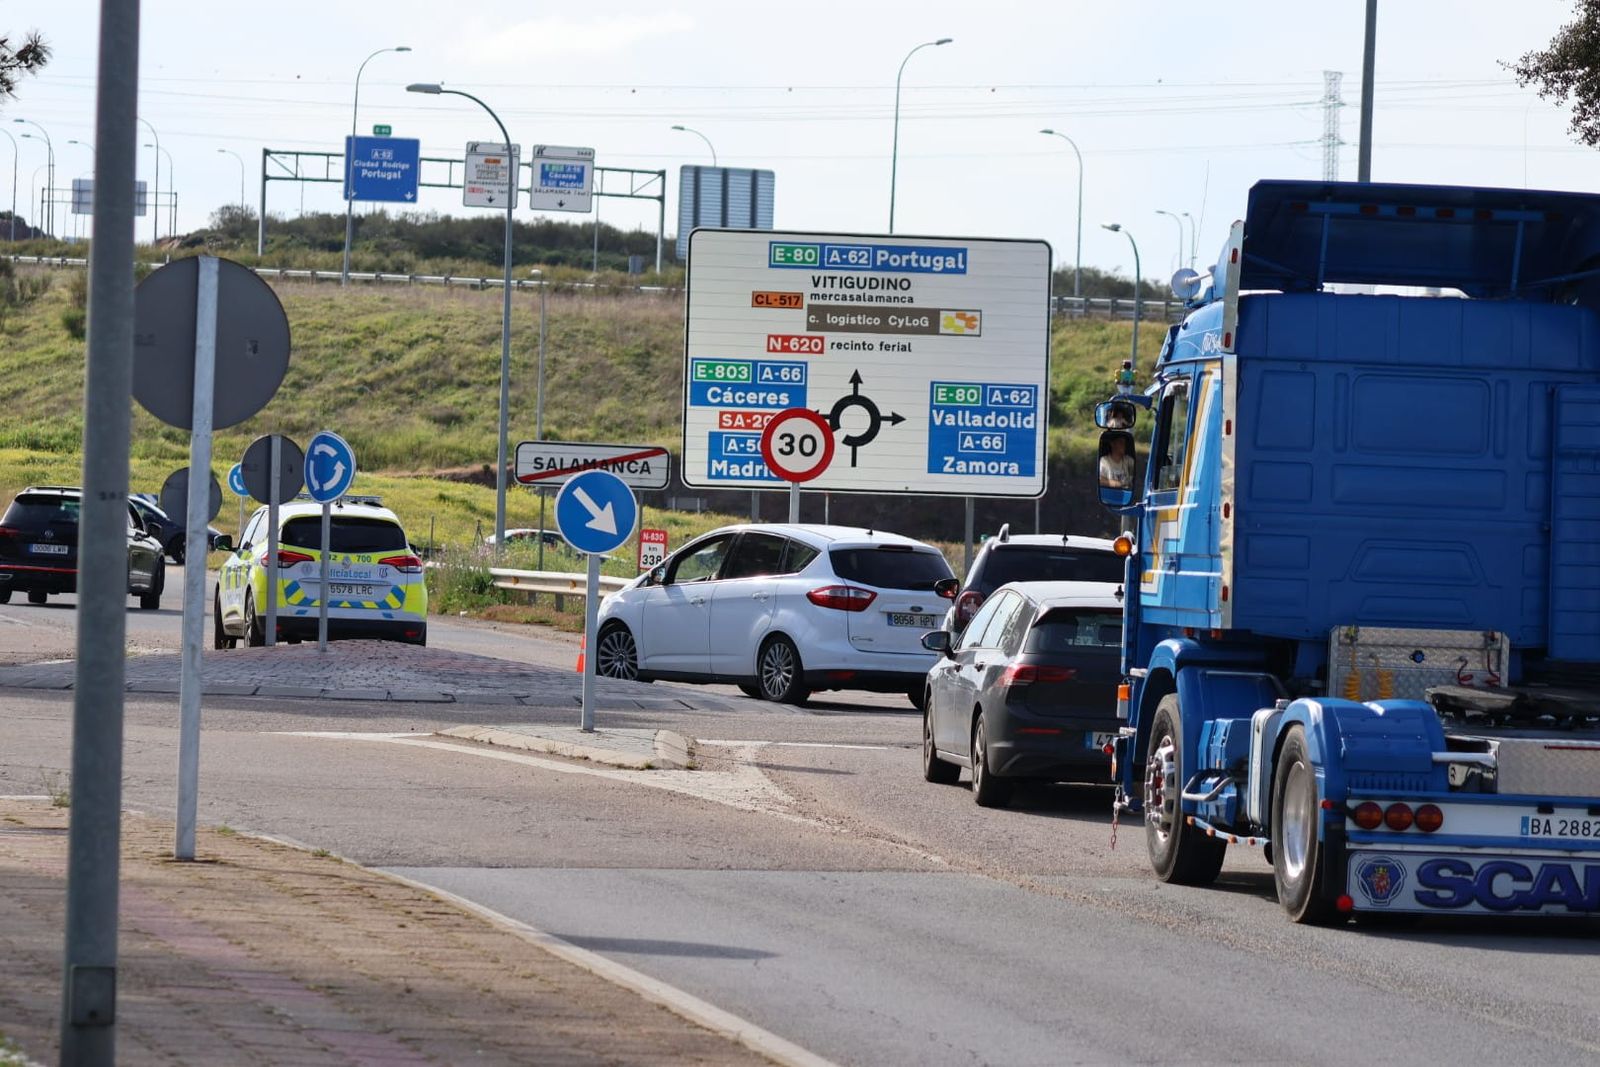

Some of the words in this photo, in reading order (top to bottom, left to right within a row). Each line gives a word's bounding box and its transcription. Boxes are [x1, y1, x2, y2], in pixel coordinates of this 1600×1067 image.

[354, 160, 379, 168] Ciudad
[382, 161, 410, 169] Rodrigo
[361, 168, 401, 180] Portugal
[775, 247, 816, 262] E-80
[829, 250, 869, 264] A-62
[876, 249, 965, 272] Portugal
[811, 275, 911, 291] VITIGUDINO
[754, 294, 800, 306] CL-517
[810, 292, 914, 304] mercasalamanca
[808, 314, 819, 324] c.
[888, 315, 929, 328] CyLoG
[769, 337, 822, 352] N-620
[830, 340, 874, 352] recinto
[879, 340, 912, 352] ferial
[696, 364, 748, 379] E-803
[761, 367, 801, 381] A-66
[706, 386, 790, 405] Cáceres
[937, 387, 978, 402] E-80
[991, 389, 1031, 404] A-62
[931, 409, 1036, 429] Valladolid
[726, 438, 761, 453] A-5
[778, 433, 817, 457] 30
[962, 435, 1003, 450] A-66
[532, 456, 652, 475] SALAMANCA
[711, 459, 779, 478] Madri
[942, 456, 1020, 475] Zamora
[642, 532, 665, 542] N-630
[356, 554, 372, 563] 700
[330, 584, 353, 594] 5578
[355, 586, 373, 595] LRC
[1531, 818, 1552, 836] BA
